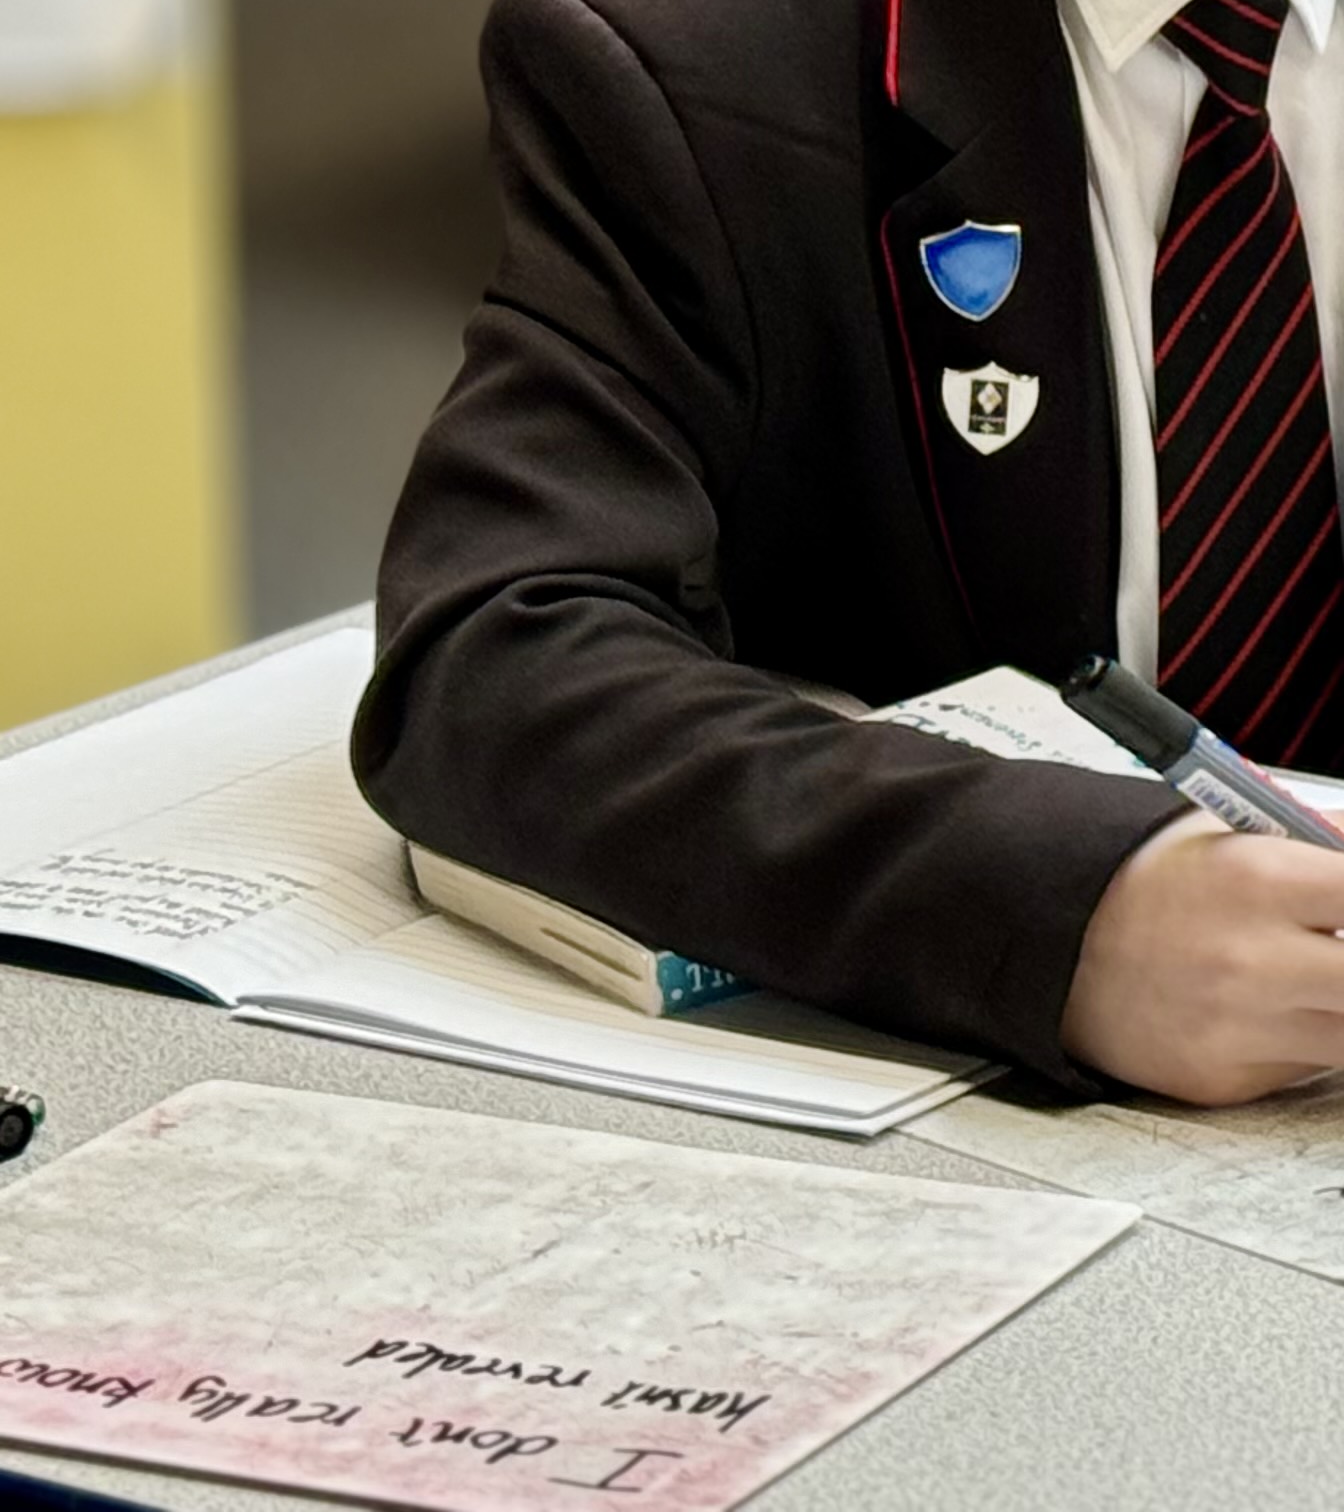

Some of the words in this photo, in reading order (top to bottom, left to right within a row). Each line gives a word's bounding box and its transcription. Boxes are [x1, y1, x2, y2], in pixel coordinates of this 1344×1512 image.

[343, 1336, 591, 1389] revealed
[177, 1375, 363, 1427] really
[547, 1447, 688, 1492] I
